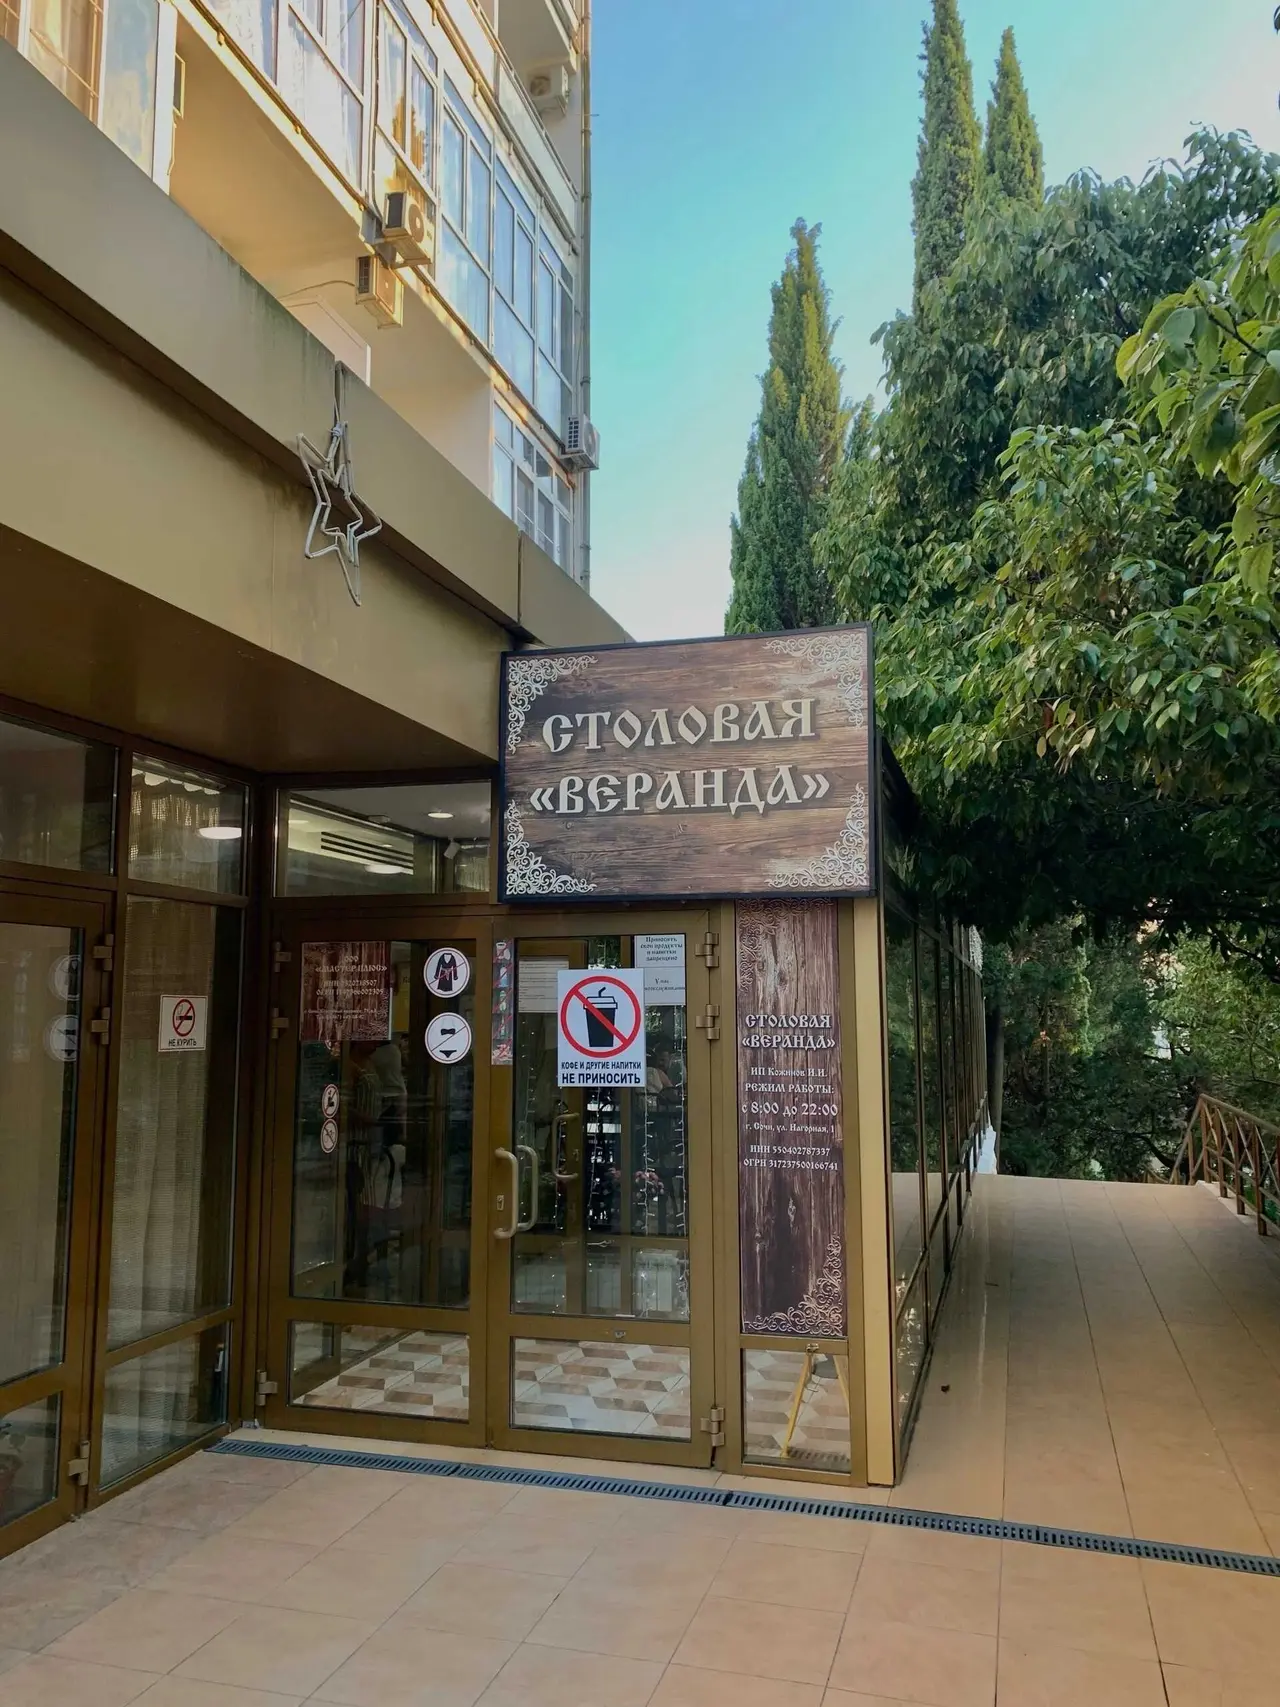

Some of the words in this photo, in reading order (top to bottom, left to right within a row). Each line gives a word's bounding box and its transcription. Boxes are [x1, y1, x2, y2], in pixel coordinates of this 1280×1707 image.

[543, 698, 816, 753] СТОЛОВАЯ
[529, 765, 831, 816] «ВЕРАНДА»
[745, 1014, 832, 1028] СТОЛОВАЯ
[168, 1039, 176, 1047] НЕ
[177, 1038, 197, 1046] КУРИТЬ
[742, 1034, 836, 1051] «ВЕРАНДА»
[561, 1061, 579, 1070] КОФЕ
[579, 1061, 585, 1069] И
[585, 1061, 610, 1071] ДРУГИЕ
[611, 1061, 642, 1070] НАПИТКИ
[751, 1066, 766, 1076] ИП
[562, 1072, 576, 1084] НЕ
[578, 1072, 641, 1084] ПРИНОСИТЬ
[745, 1082, 786, 1093] РЕЖИМ
[788, 1083, 835, 1094] РАБОТЫ:
[751, 1101, 779, 1114] 8:00
[782, 1105, 798, 1117] до
[801, 1103, 838, 1116] 22:00
[753, 1122, 775, 1132] Сочи,
[776, 1124, 788, 1133] ул.
[790, 1123, 829, 1134] Нагорная,
[750, 1144, 770, 1153] ИНН
[772, 1146, 831, 1156] 550402787337
[743, 1158, 767, 1167] ОГРН
[769, 1159, 838, 1170] 317237500166741
